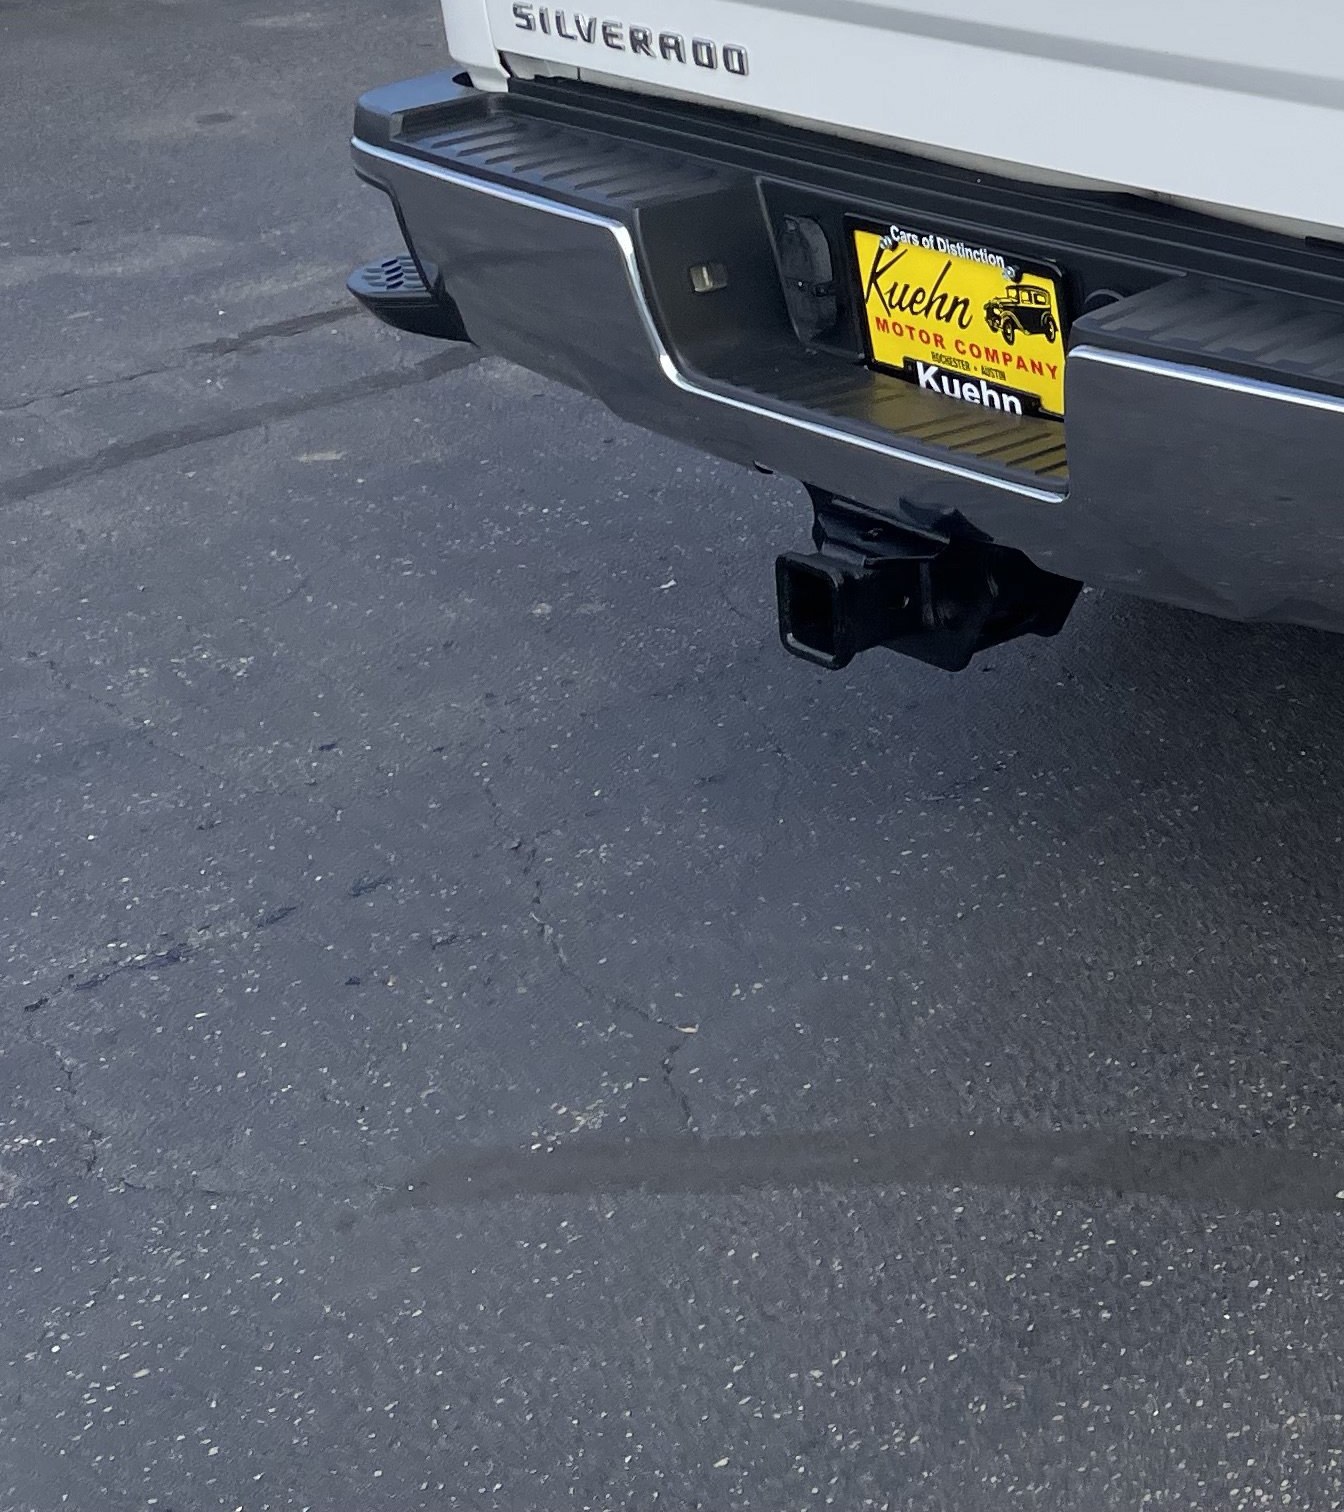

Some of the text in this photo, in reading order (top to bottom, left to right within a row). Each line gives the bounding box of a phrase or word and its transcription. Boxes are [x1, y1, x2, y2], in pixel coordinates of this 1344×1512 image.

[512, 1, 749, 77] SILVERADO
[890, 224, 1005, 270] Cars of Distinction
[864, 241, 974, 330] Kuehn
[875, 316, 1058, 380] MOTOR COMPANY
[930, 351, 1007, 381] ROCHESTER AUSTIN
[916, 360, 1023, 415] Kuehn
